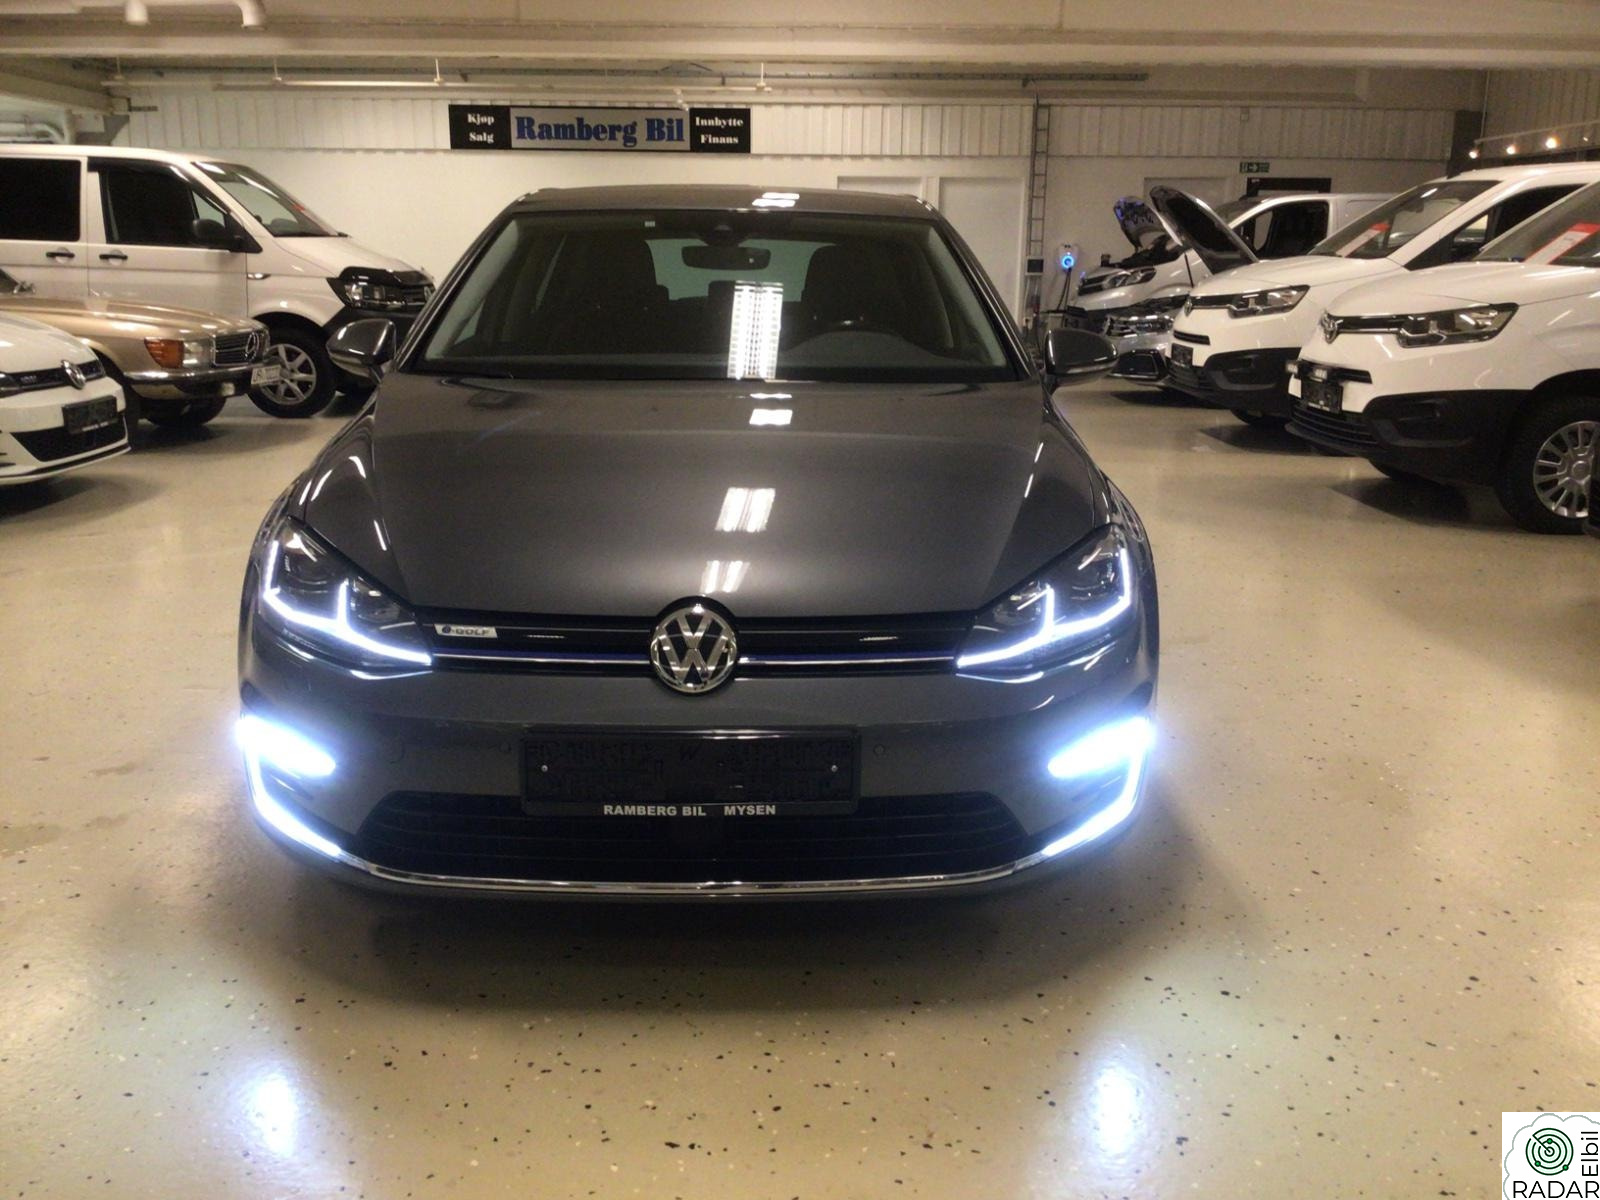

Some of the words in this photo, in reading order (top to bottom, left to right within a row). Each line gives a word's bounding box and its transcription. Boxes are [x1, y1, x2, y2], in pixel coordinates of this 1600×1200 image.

[467, 112, 494, 125] Kjøp
[695, 116, 744, 128] Innbytte
[515, 116, 637, 147] Ramberg
[645, 118, 684, 142] Bil
[469, 132, 494, 144] Salg
[700, 134, 739, 144] Finans
[603, 804, 677, 816] RAMBERG
[682, 804, 706, 816] BIL
[724, 804, 776, 816] MYSEN
